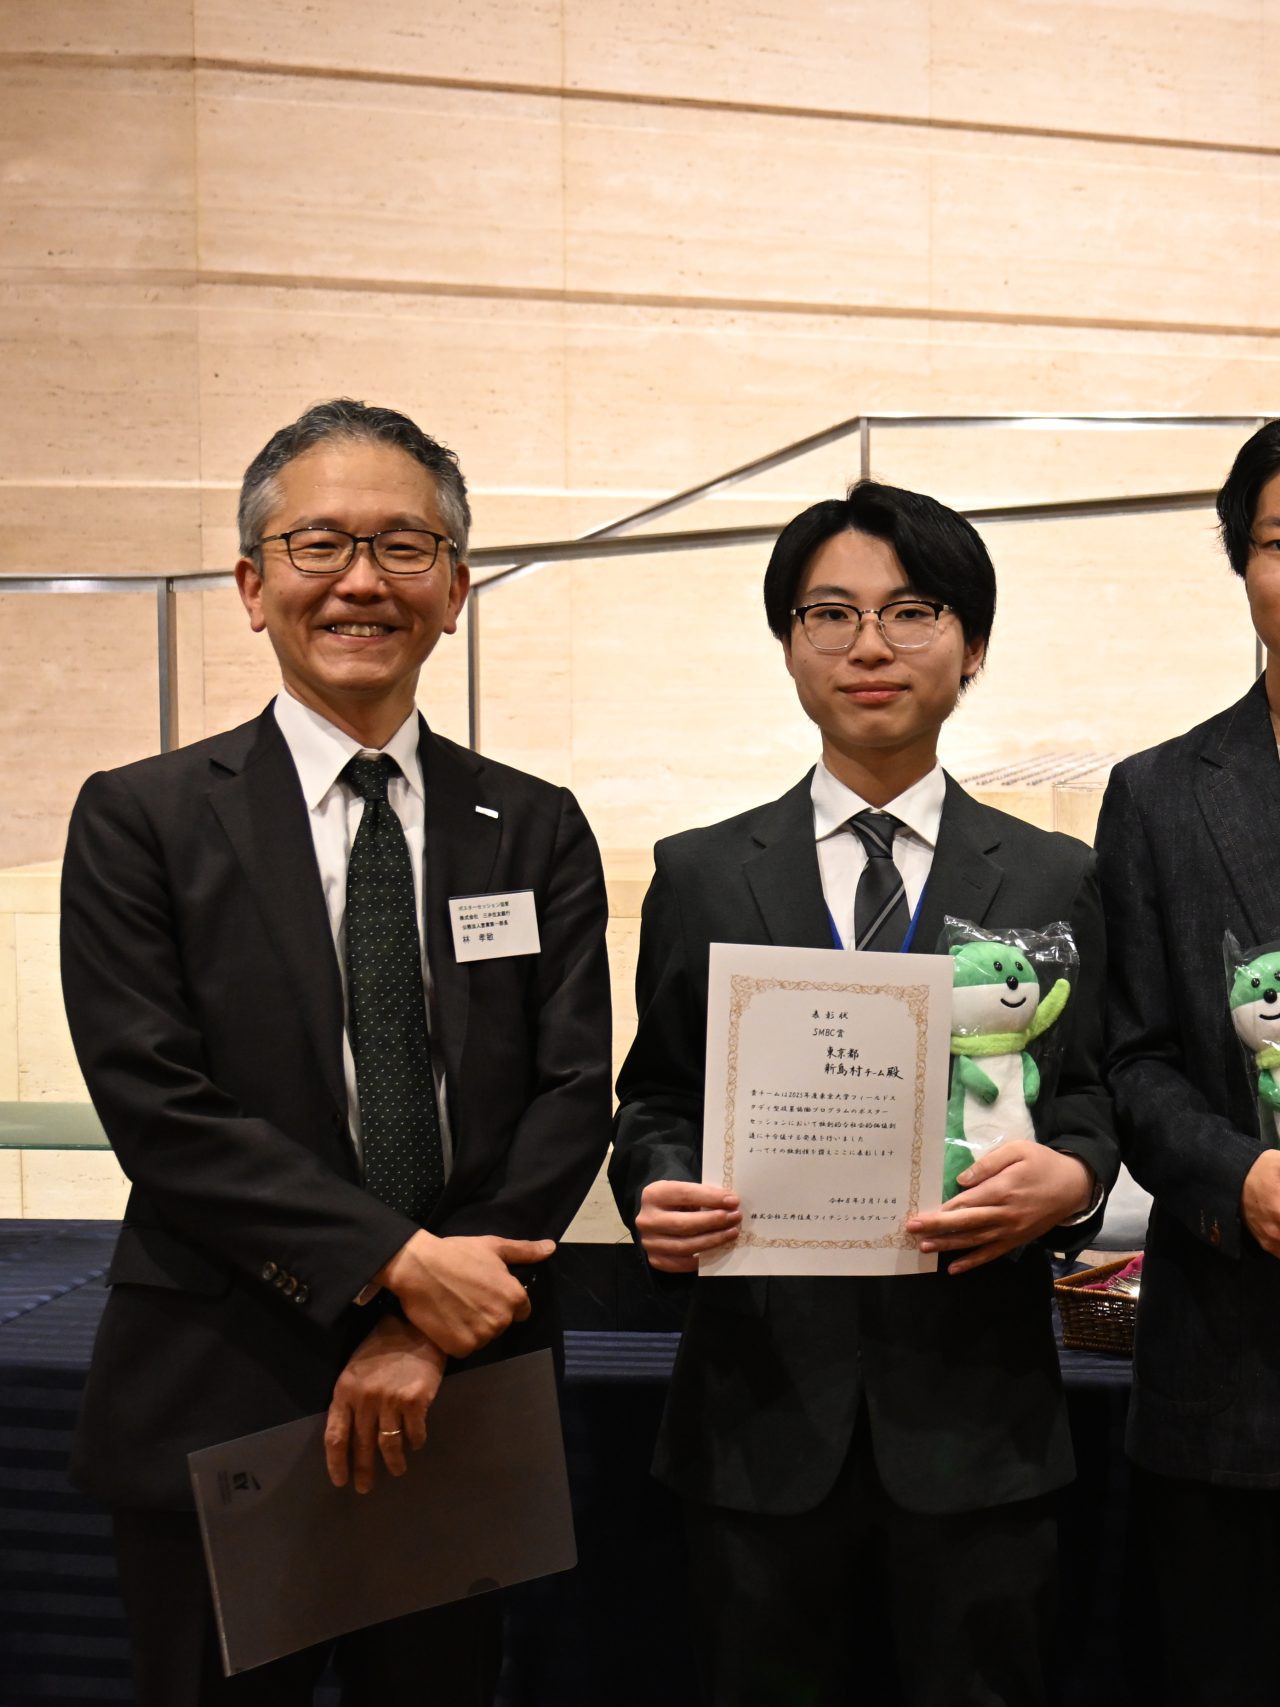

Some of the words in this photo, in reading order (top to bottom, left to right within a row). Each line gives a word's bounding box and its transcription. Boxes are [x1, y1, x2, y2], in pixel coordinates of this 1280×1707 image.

[462, 935, 470, 943] 林
[811, 1009, 849, 1020] 表彰状
[812, 1028, 845, 1038] SMBC賞
[826, 1046, 859, 1060] 東京都
